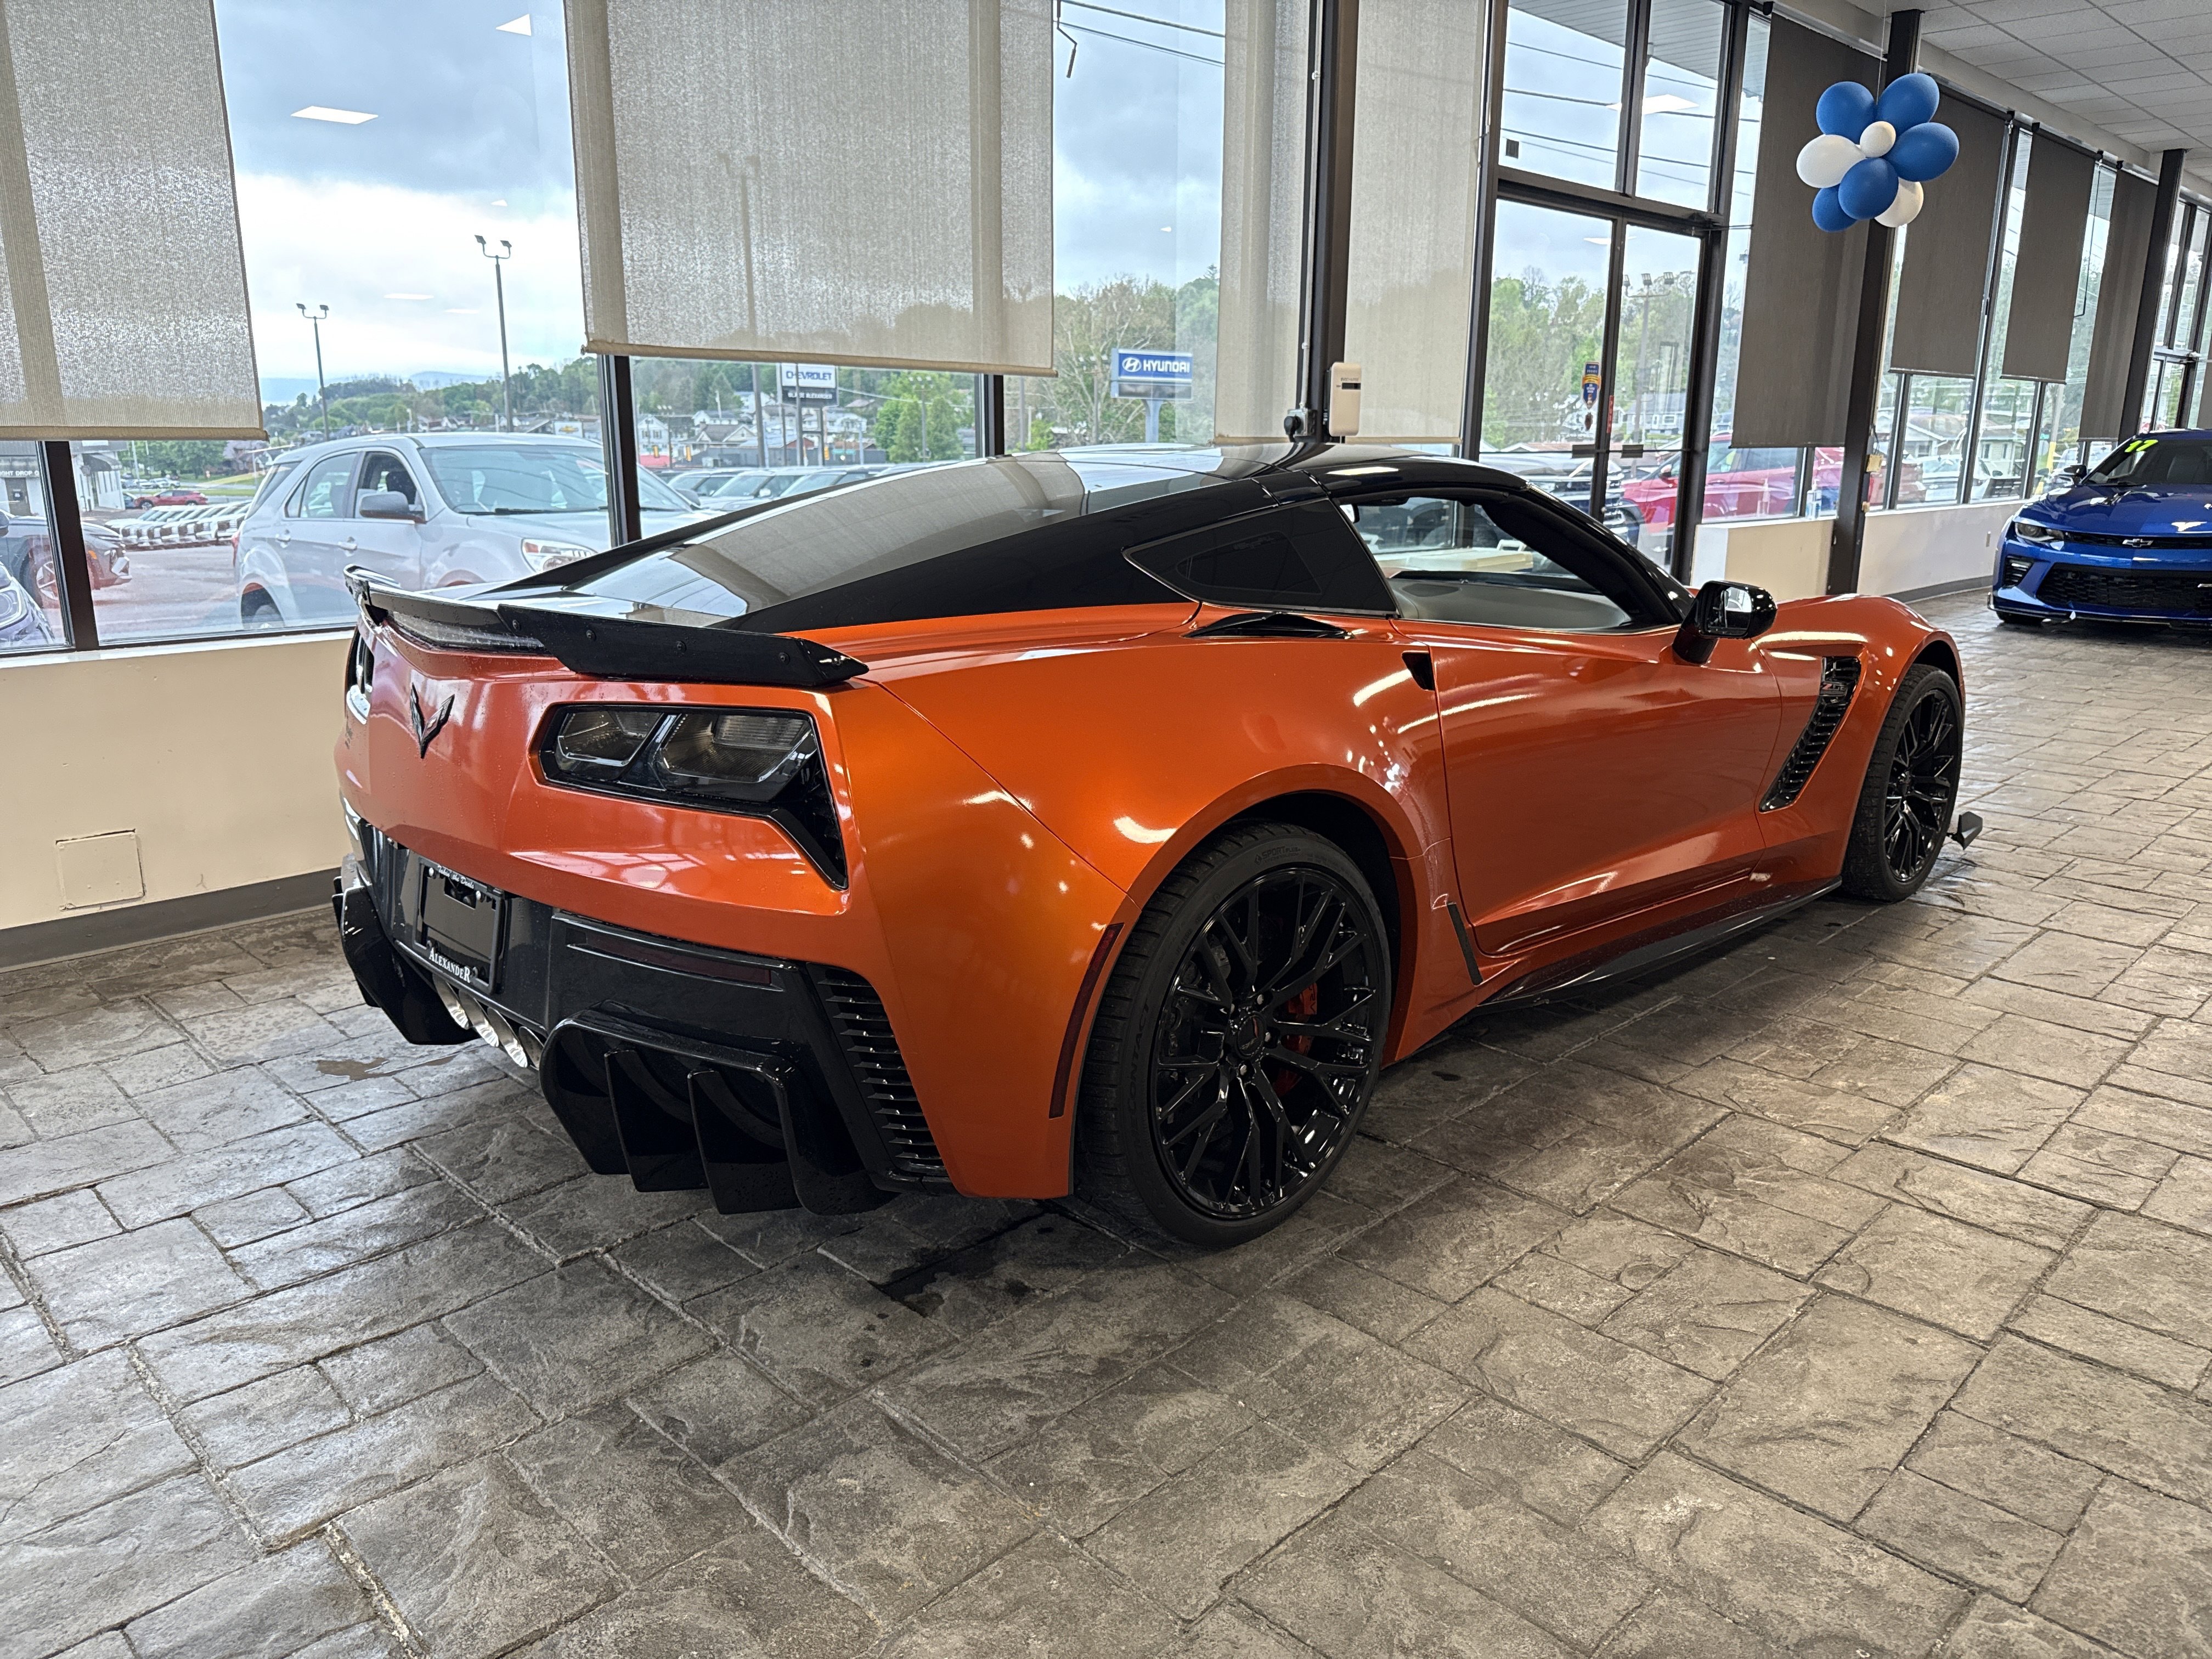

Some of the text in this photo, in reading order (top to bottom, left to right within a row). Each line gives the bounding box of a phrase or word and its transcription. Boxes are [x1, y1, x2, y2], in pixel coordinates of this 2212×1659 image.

[1143, 359, 1190, 373] HYUNDAI
[2124, 439, 2159, 453] 17
[461, 876, 474, 889] Deals
[429, 947, 470, 983] ALEXANDER
